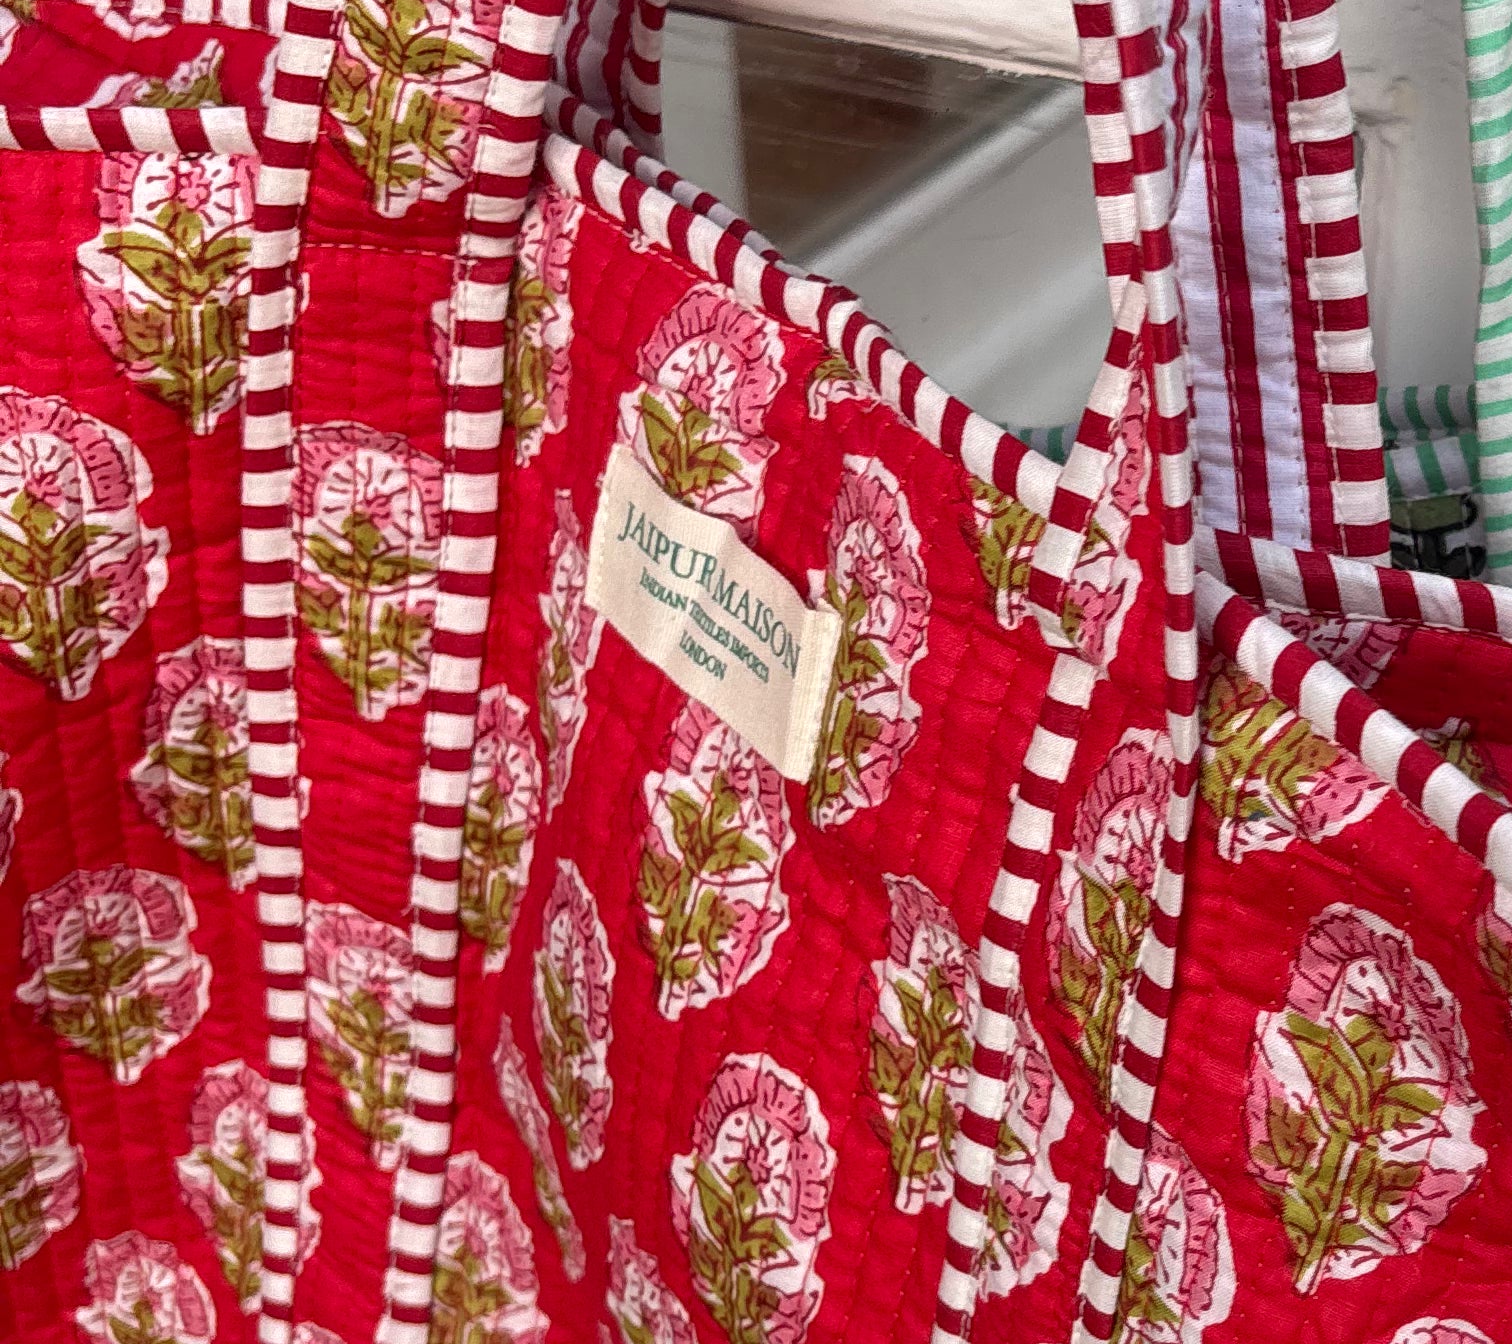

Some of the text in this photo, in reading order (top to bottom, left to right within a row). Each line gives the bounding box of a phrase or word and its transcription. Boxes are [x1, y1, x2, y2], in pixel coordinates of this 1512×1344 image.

[617, 501, 801, 679] JAIPUR MAISON
[639, 566, 688, 611] INDIAN
[679, 629, 728, 681] LONDON
